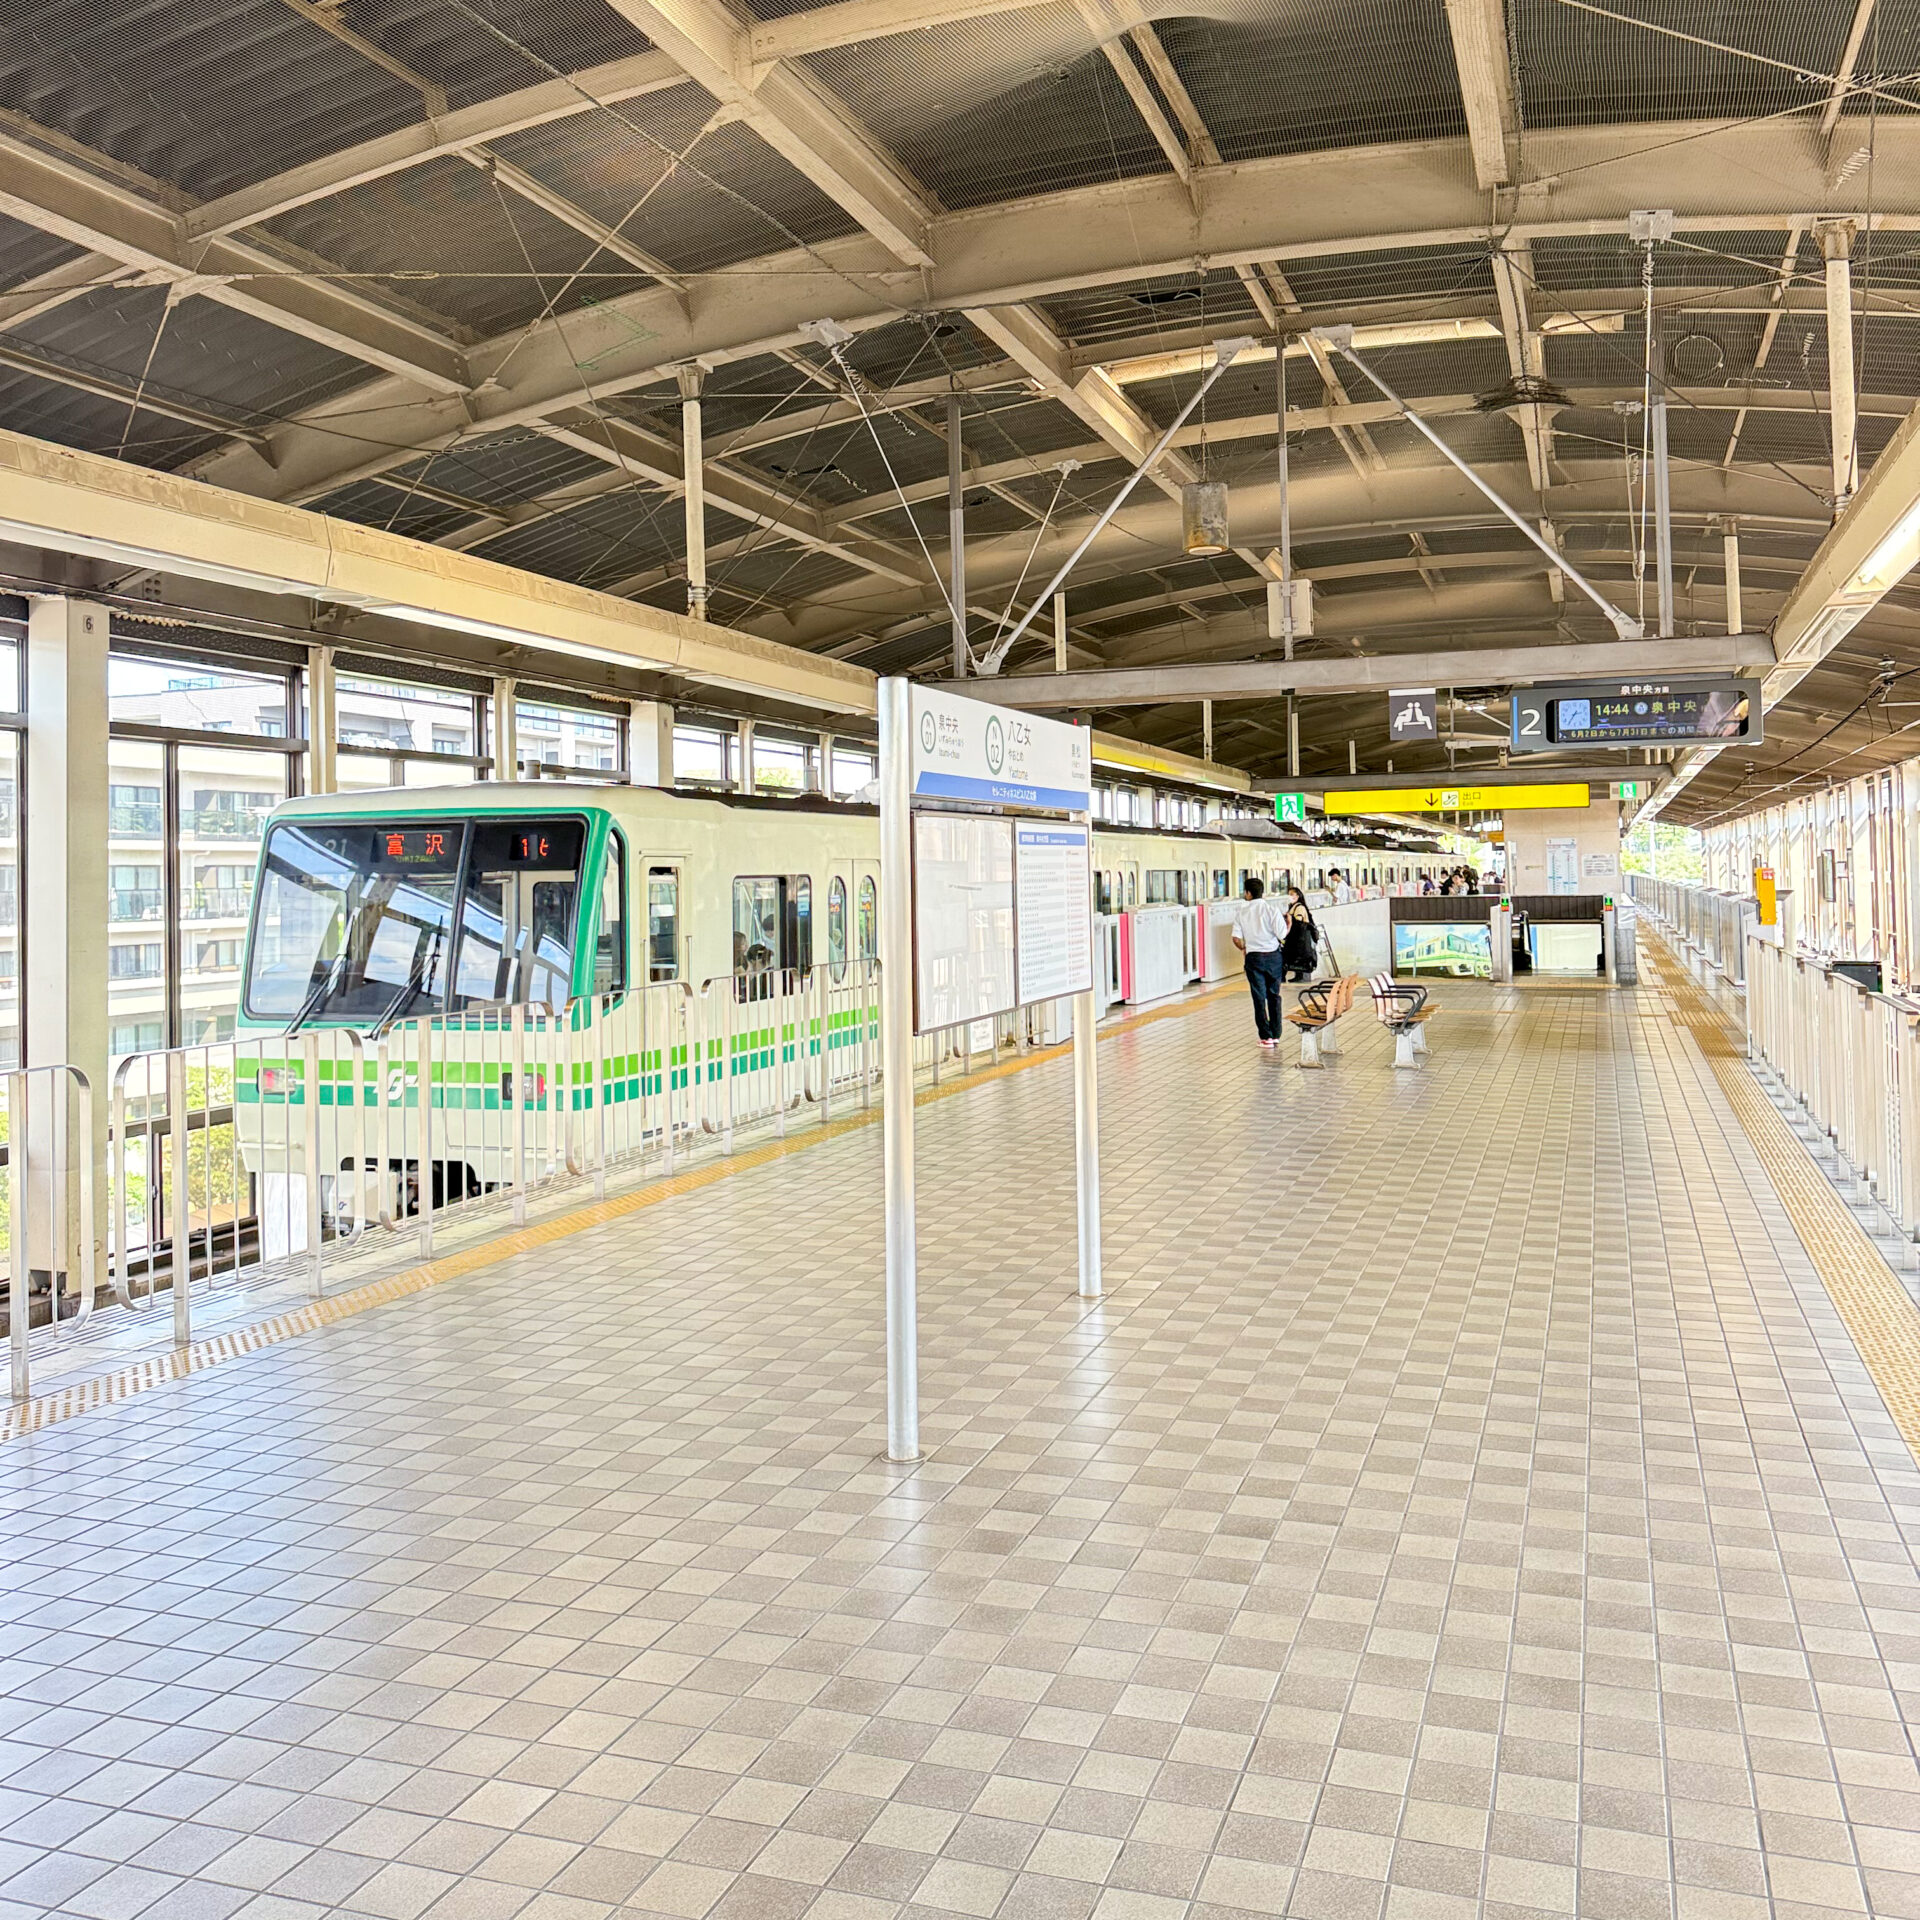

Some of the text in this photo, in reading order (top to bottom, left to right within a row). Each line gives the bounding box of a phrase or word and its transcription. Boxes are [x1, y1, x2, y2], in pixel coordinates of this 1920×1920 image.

[1621, 685, 1669, 695] 泉中央方面
[1595, 704, 1629, 716] 14:44
[1651, 701, 1697, 714] 泉中央
[939, 713, 958, 734] 泉中央
[1520, 709, 1541, 735] 2
[1008, 721, 1031, 746] 八乙女
[991, 744, 1000, 764] 02
[1463, 792, 1481, 800] 出口
[386, 833, 444, 855] 富沢
